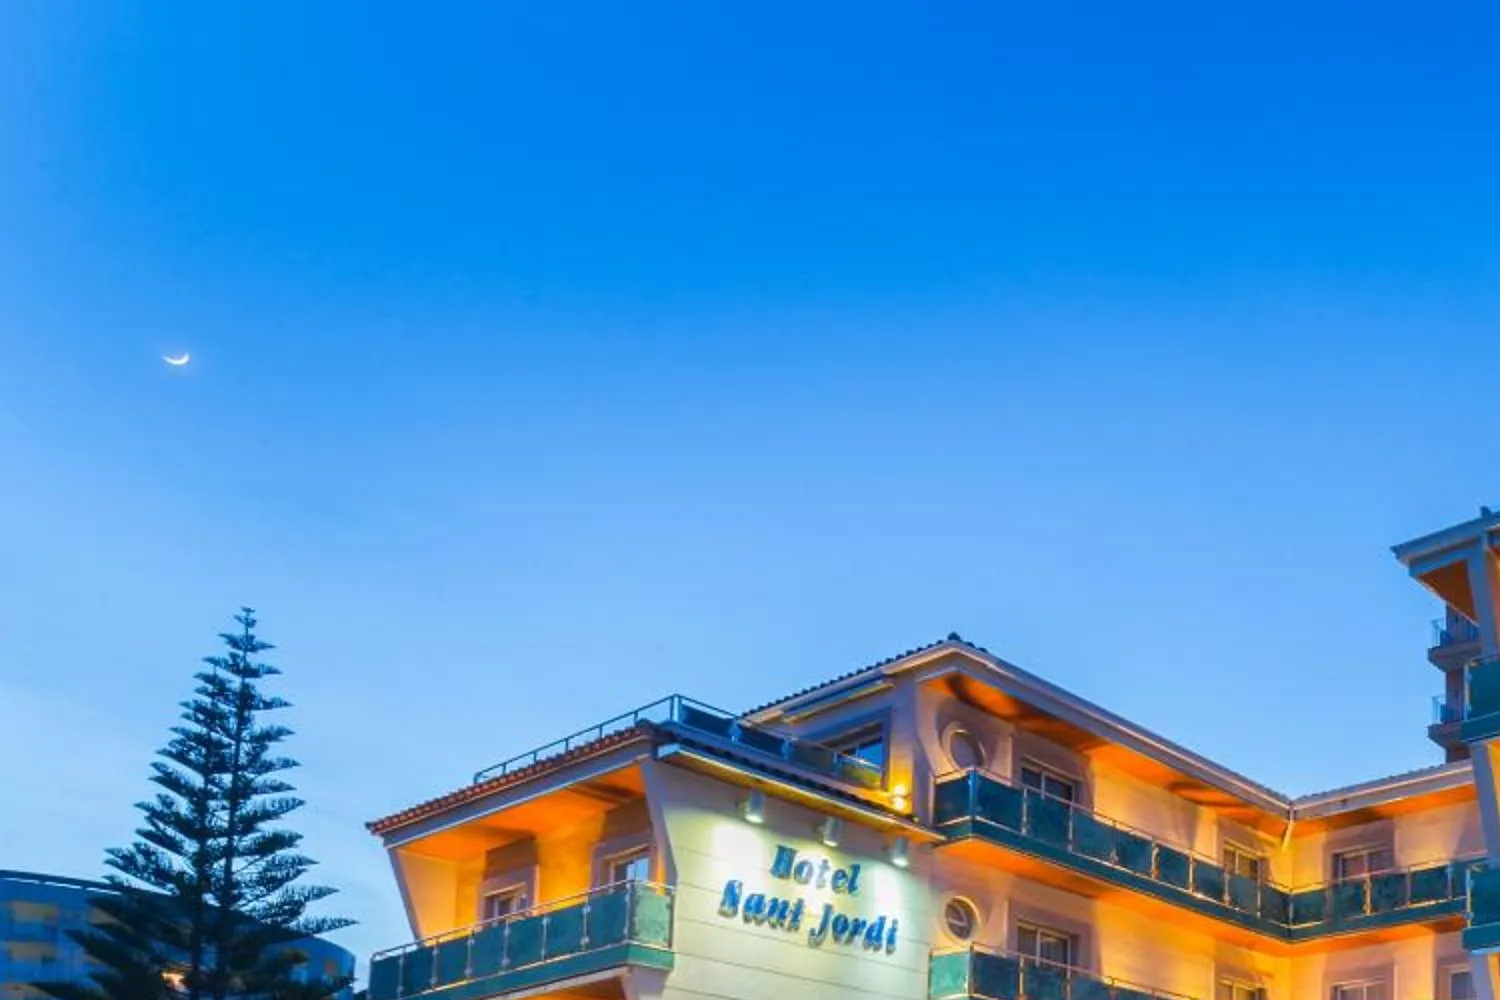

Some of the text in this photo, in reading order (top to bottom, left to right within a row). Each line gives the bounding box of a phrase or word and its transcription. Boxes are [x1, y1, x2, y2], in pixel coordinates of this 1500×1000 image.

[770, 845, 861, 895] Hotel
[718, 880, 898, 955] Sant Jordi
